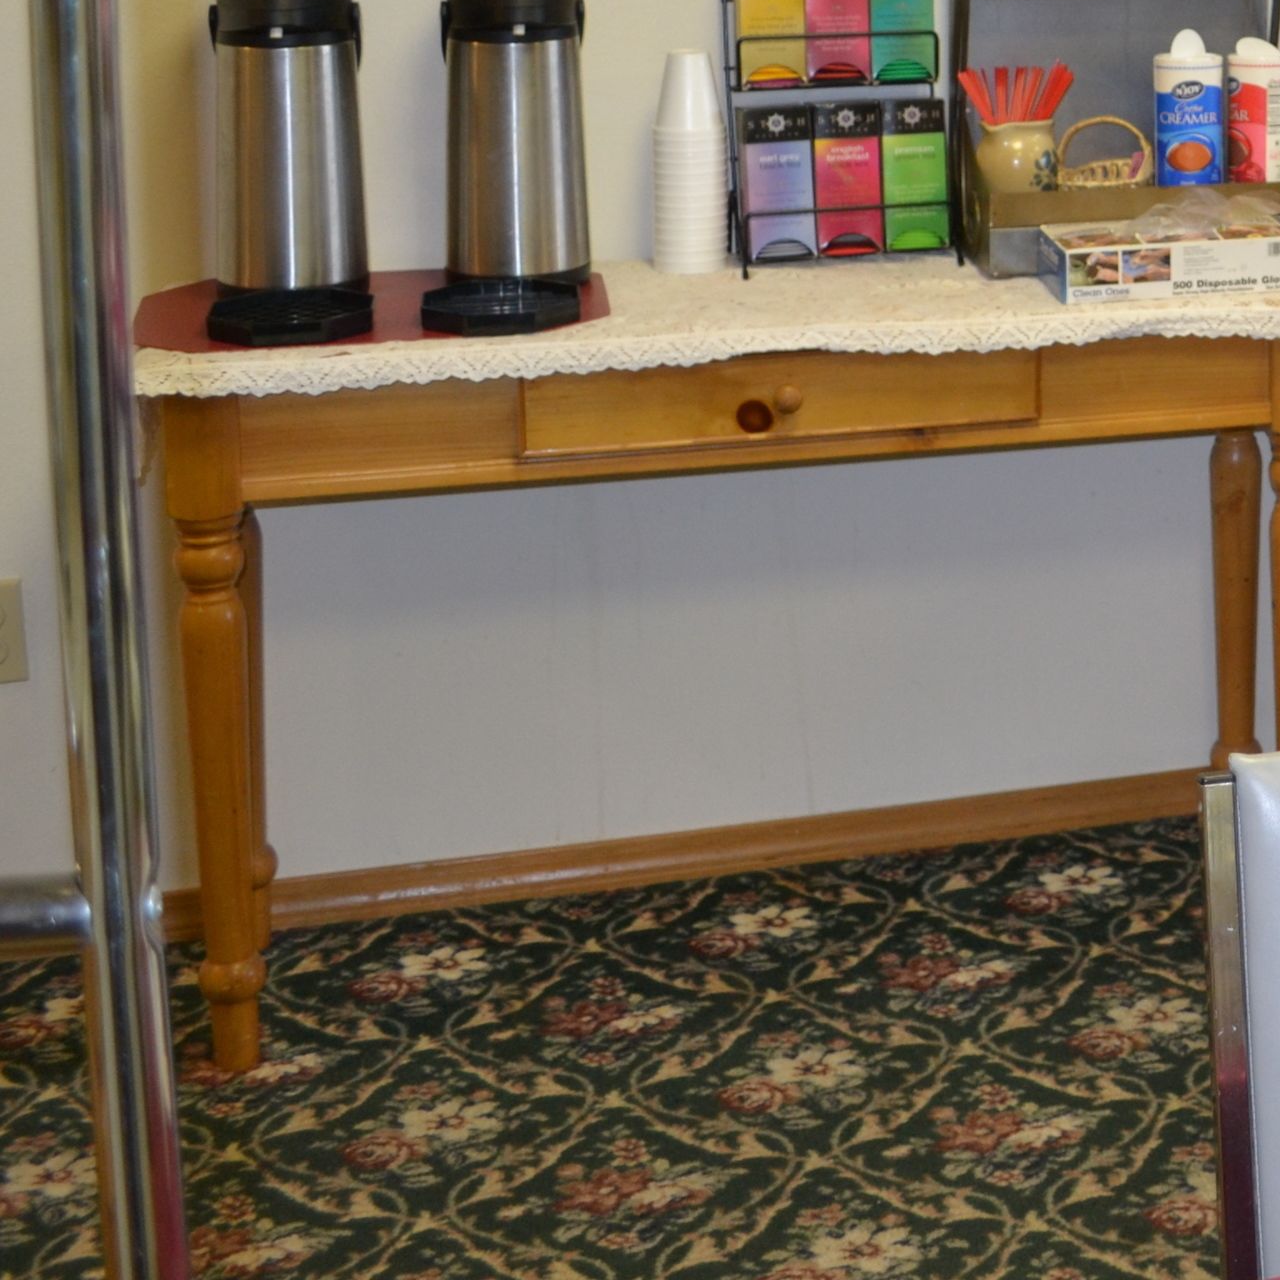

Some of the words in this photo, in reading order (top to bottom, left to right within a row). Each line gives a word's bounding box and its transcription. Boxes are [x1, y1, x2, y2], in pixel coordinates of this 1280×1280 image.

[1159, 111, 1218, 125] CREAMER
[1172, 280, 1193, 290] 500
[1196, 277, 1258, 288] Disposable
[1073, 287, 1102, 298] Clean
[1105, 286, 1130, 296] Ones
